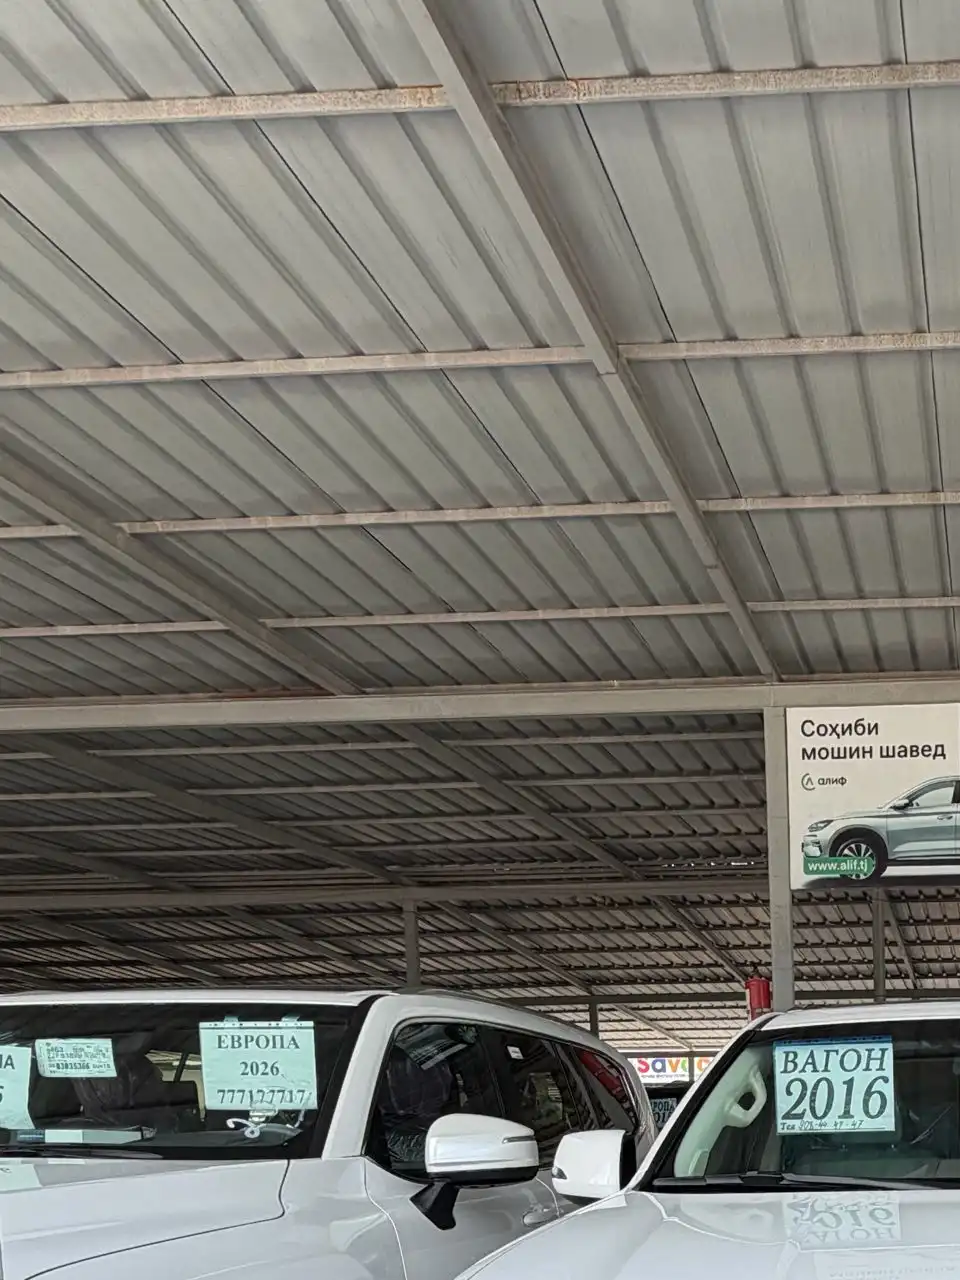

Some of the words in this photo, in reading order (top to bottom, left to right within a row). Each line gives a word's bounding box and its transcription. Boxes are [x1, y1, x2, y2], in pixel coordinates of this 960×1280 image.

[800, 718, 880, 739] Соҳиби
[801, 746, 873, 760] мошин
[879, 744, 947, 760] шавед
[818, 775, 848, 787] алиф
[807, 857, 869, 873] www.alif.tj
[217, 1034, 301, 1050] ЕВРОПА
[239, 1061, 281, 1076] 2026
[780, 1047, 889, 1074] ВАГОН
[780, 1075, 890, 1121] 2016
